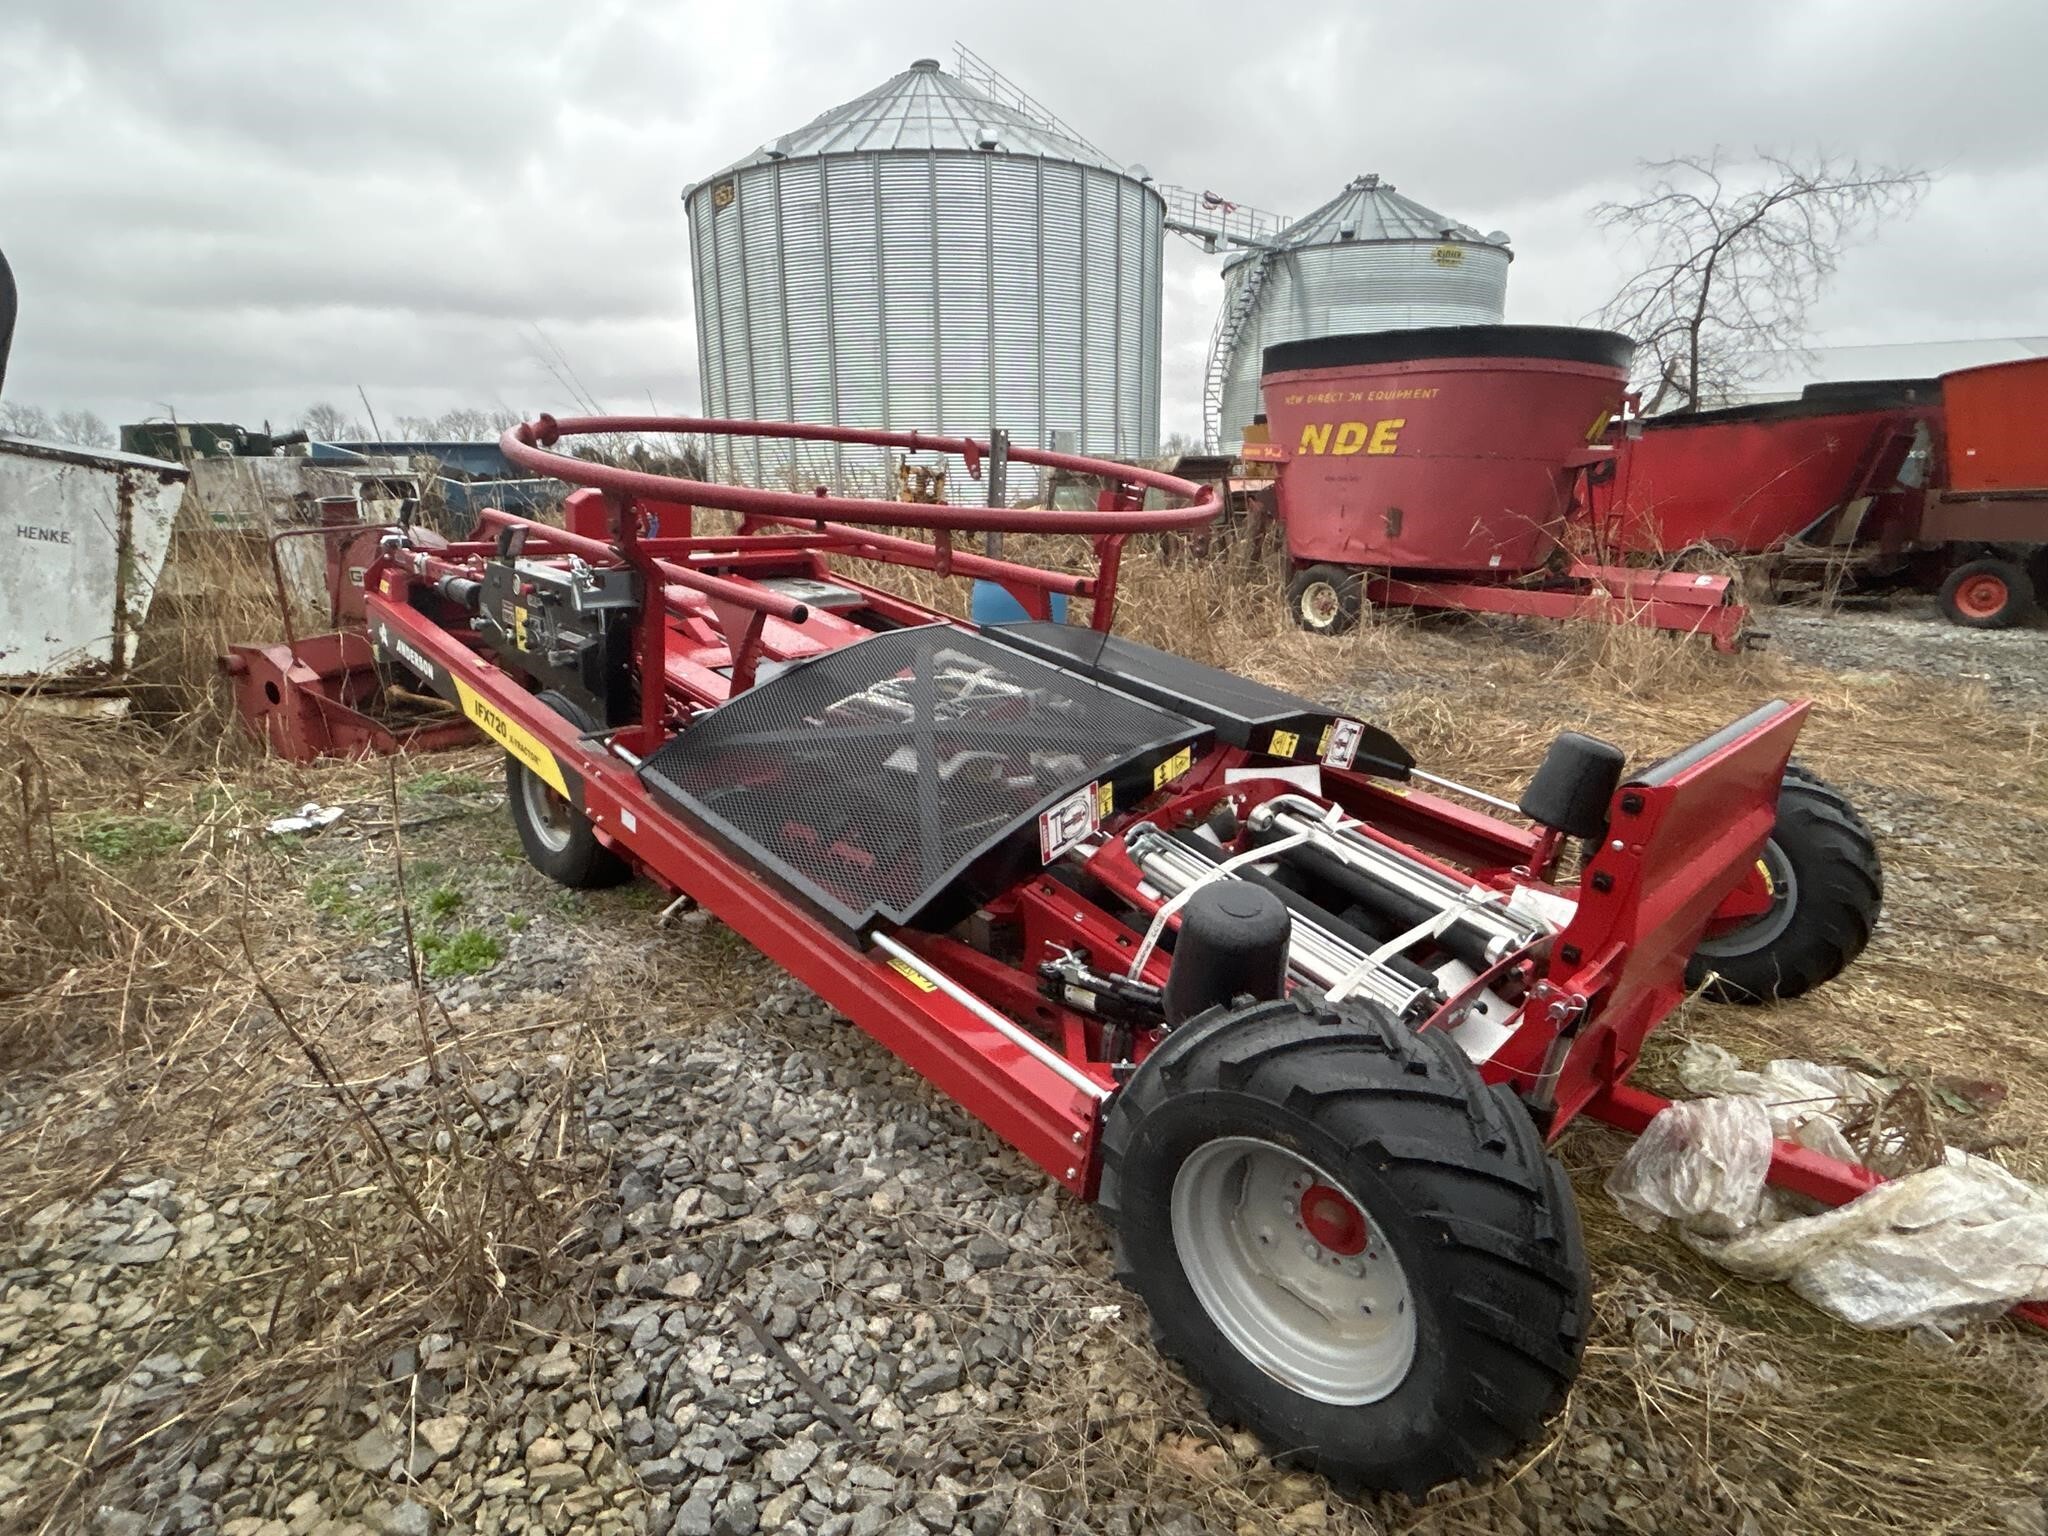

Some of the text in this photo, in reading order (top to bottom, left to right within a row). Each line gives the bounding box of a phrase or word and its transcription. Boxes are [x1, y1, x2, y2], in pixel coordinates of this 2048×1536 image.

[1368, 388, 1440, 400] EQUIPMENT
[1298, 418, 1406, 455] NDE
[17, 525, 71, 544] HENKE
[396, 639, 434, 680] ANDERSON
[474, 700, 507, 738] IFX720
